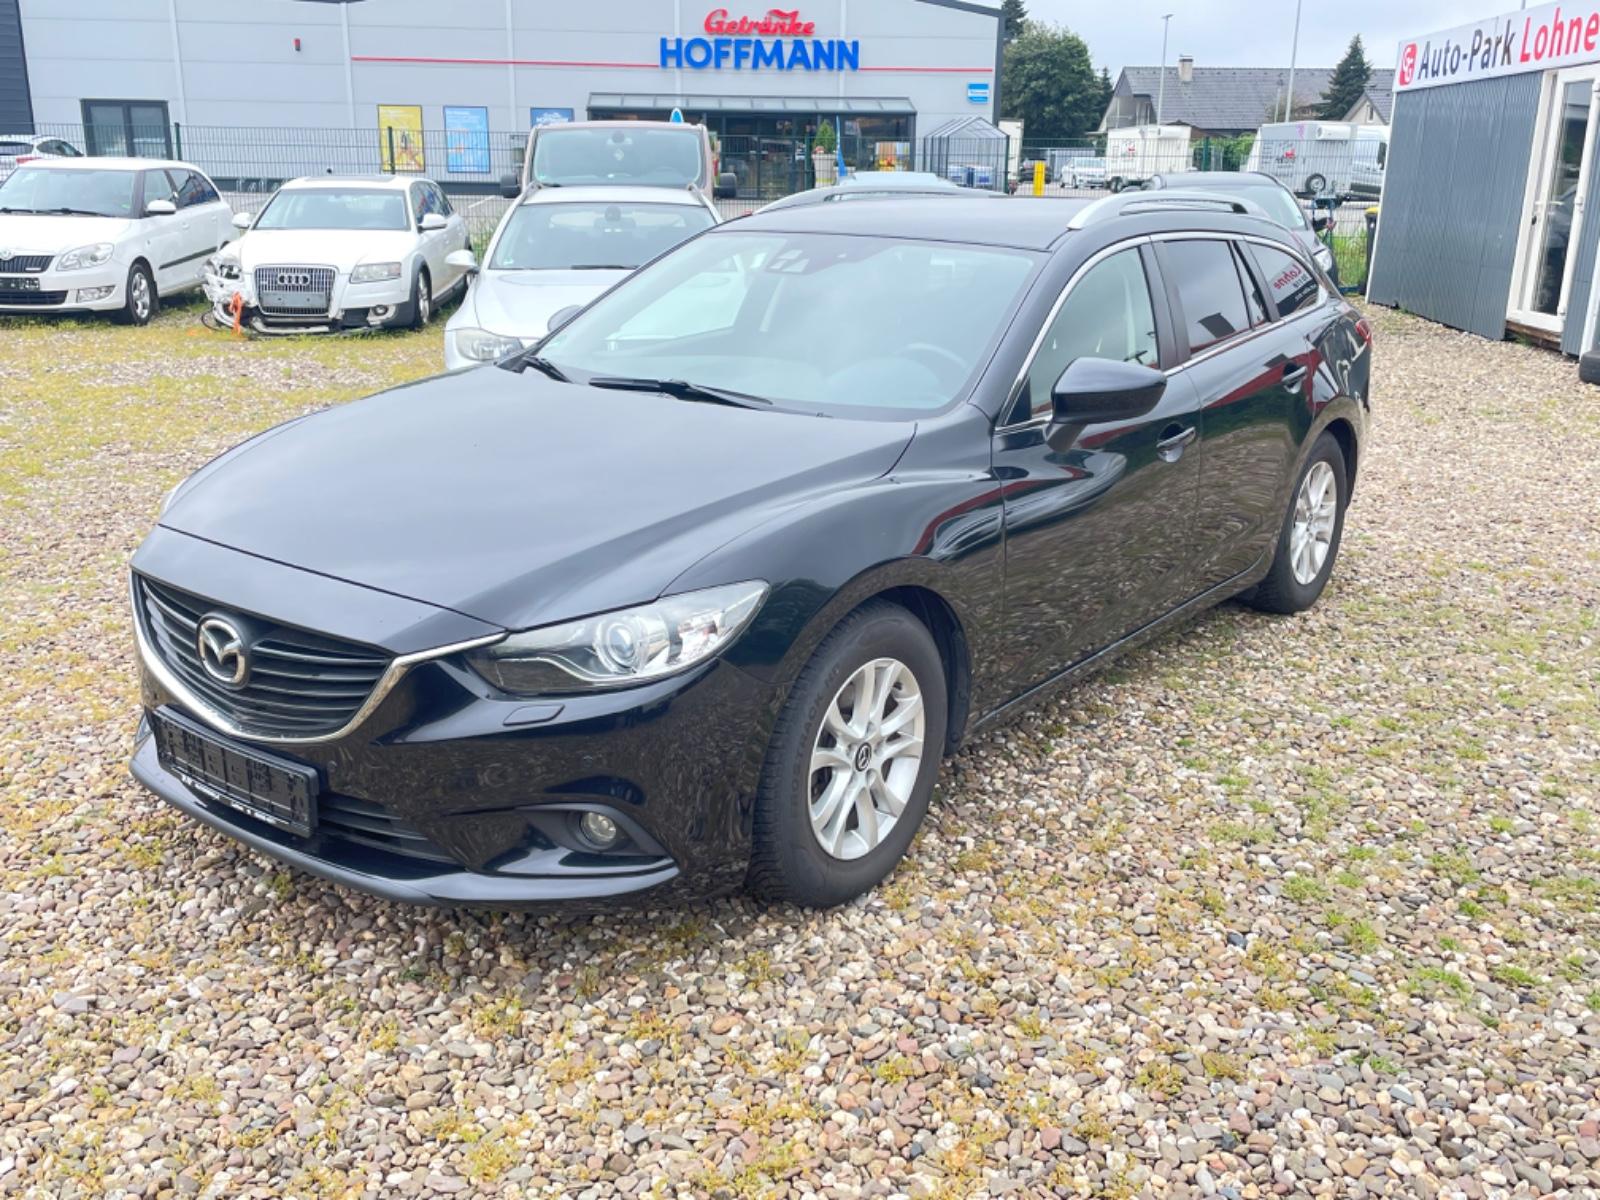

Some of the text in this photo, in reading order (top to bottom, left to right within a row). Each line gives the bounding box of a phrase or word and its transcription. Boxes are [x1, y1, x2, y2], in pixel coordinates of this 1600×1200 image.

[704, 8, 815, 36] Getränke
[660, 37, 859, 71] HOFFMANN
[1417, 7, 1600, 80] Auto-Park Lohne
